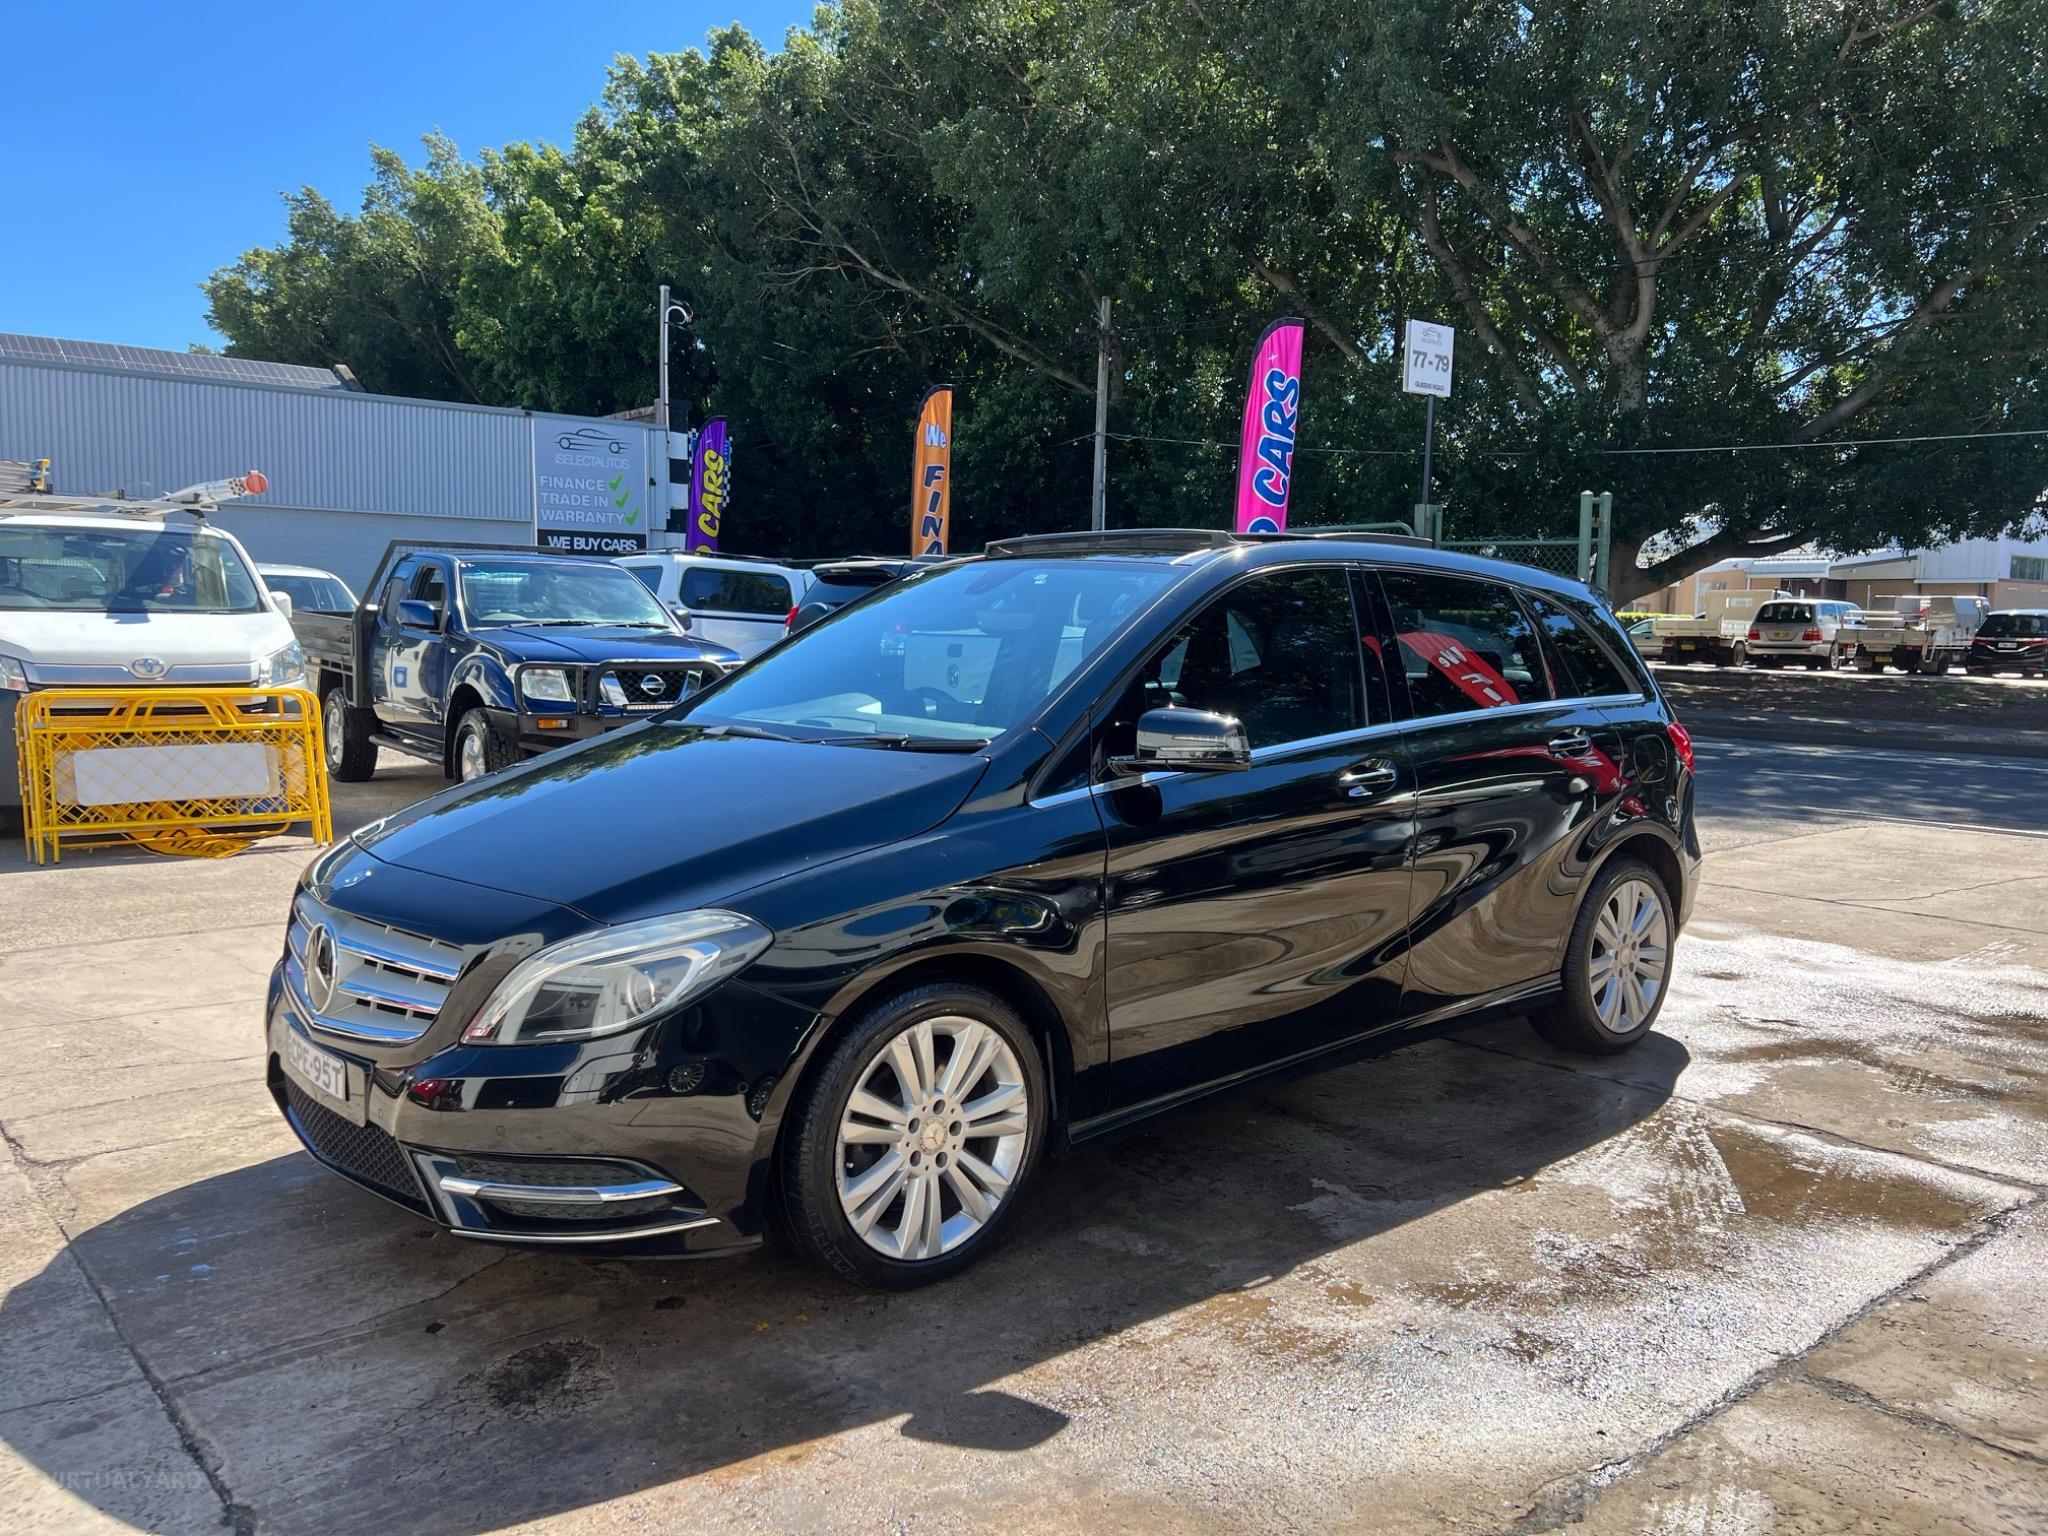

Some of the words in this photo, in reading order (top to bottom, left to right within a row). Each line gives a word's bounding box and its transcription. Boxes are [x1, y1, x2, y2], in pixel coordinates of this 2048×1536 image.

[925, 423, 947, 448] We
[1253, 367, 1299, 507] CARS
[540, 475, 605, 491] FINANCE
[540, 492, 591, 507] TRADE
[594, 494, 609, 508] IN
[697, 448, 725, 538] CARS
[541, 510, 625, 524] WARRANTY
[548, 536, 571, 550] WE
[573, 537, 602, 551] BUY
[603, 538, 638, 552] CARS
